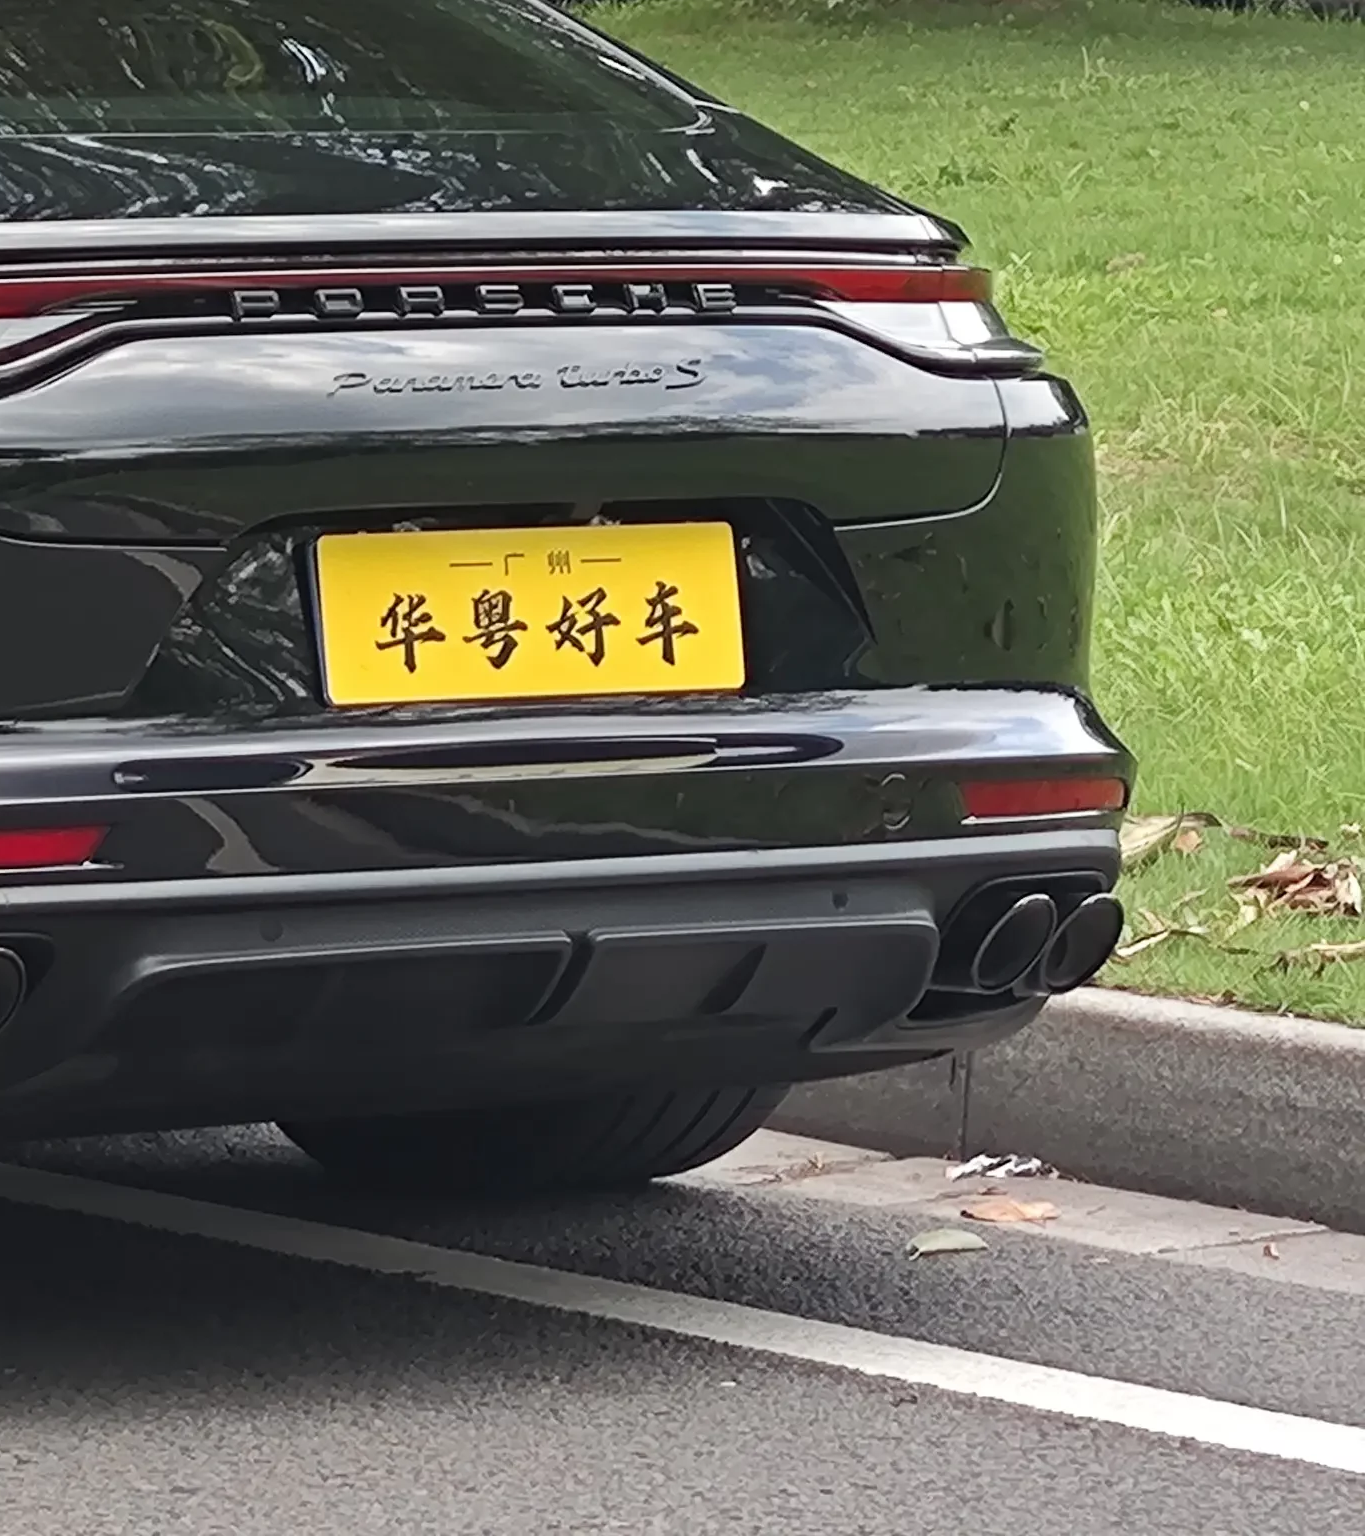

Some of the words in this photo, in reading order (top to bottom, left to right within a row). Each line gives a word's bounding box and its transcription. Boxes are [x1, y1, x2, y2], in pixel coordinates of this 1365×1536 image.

[231, 282, 737, 322] PORSCHE
[326, 371, 541, 398] Panamera
[665, 359, 708, 390] S
[504, 549, 572, 577] 广州
[375, 580, 700, 674] 华粤好车
